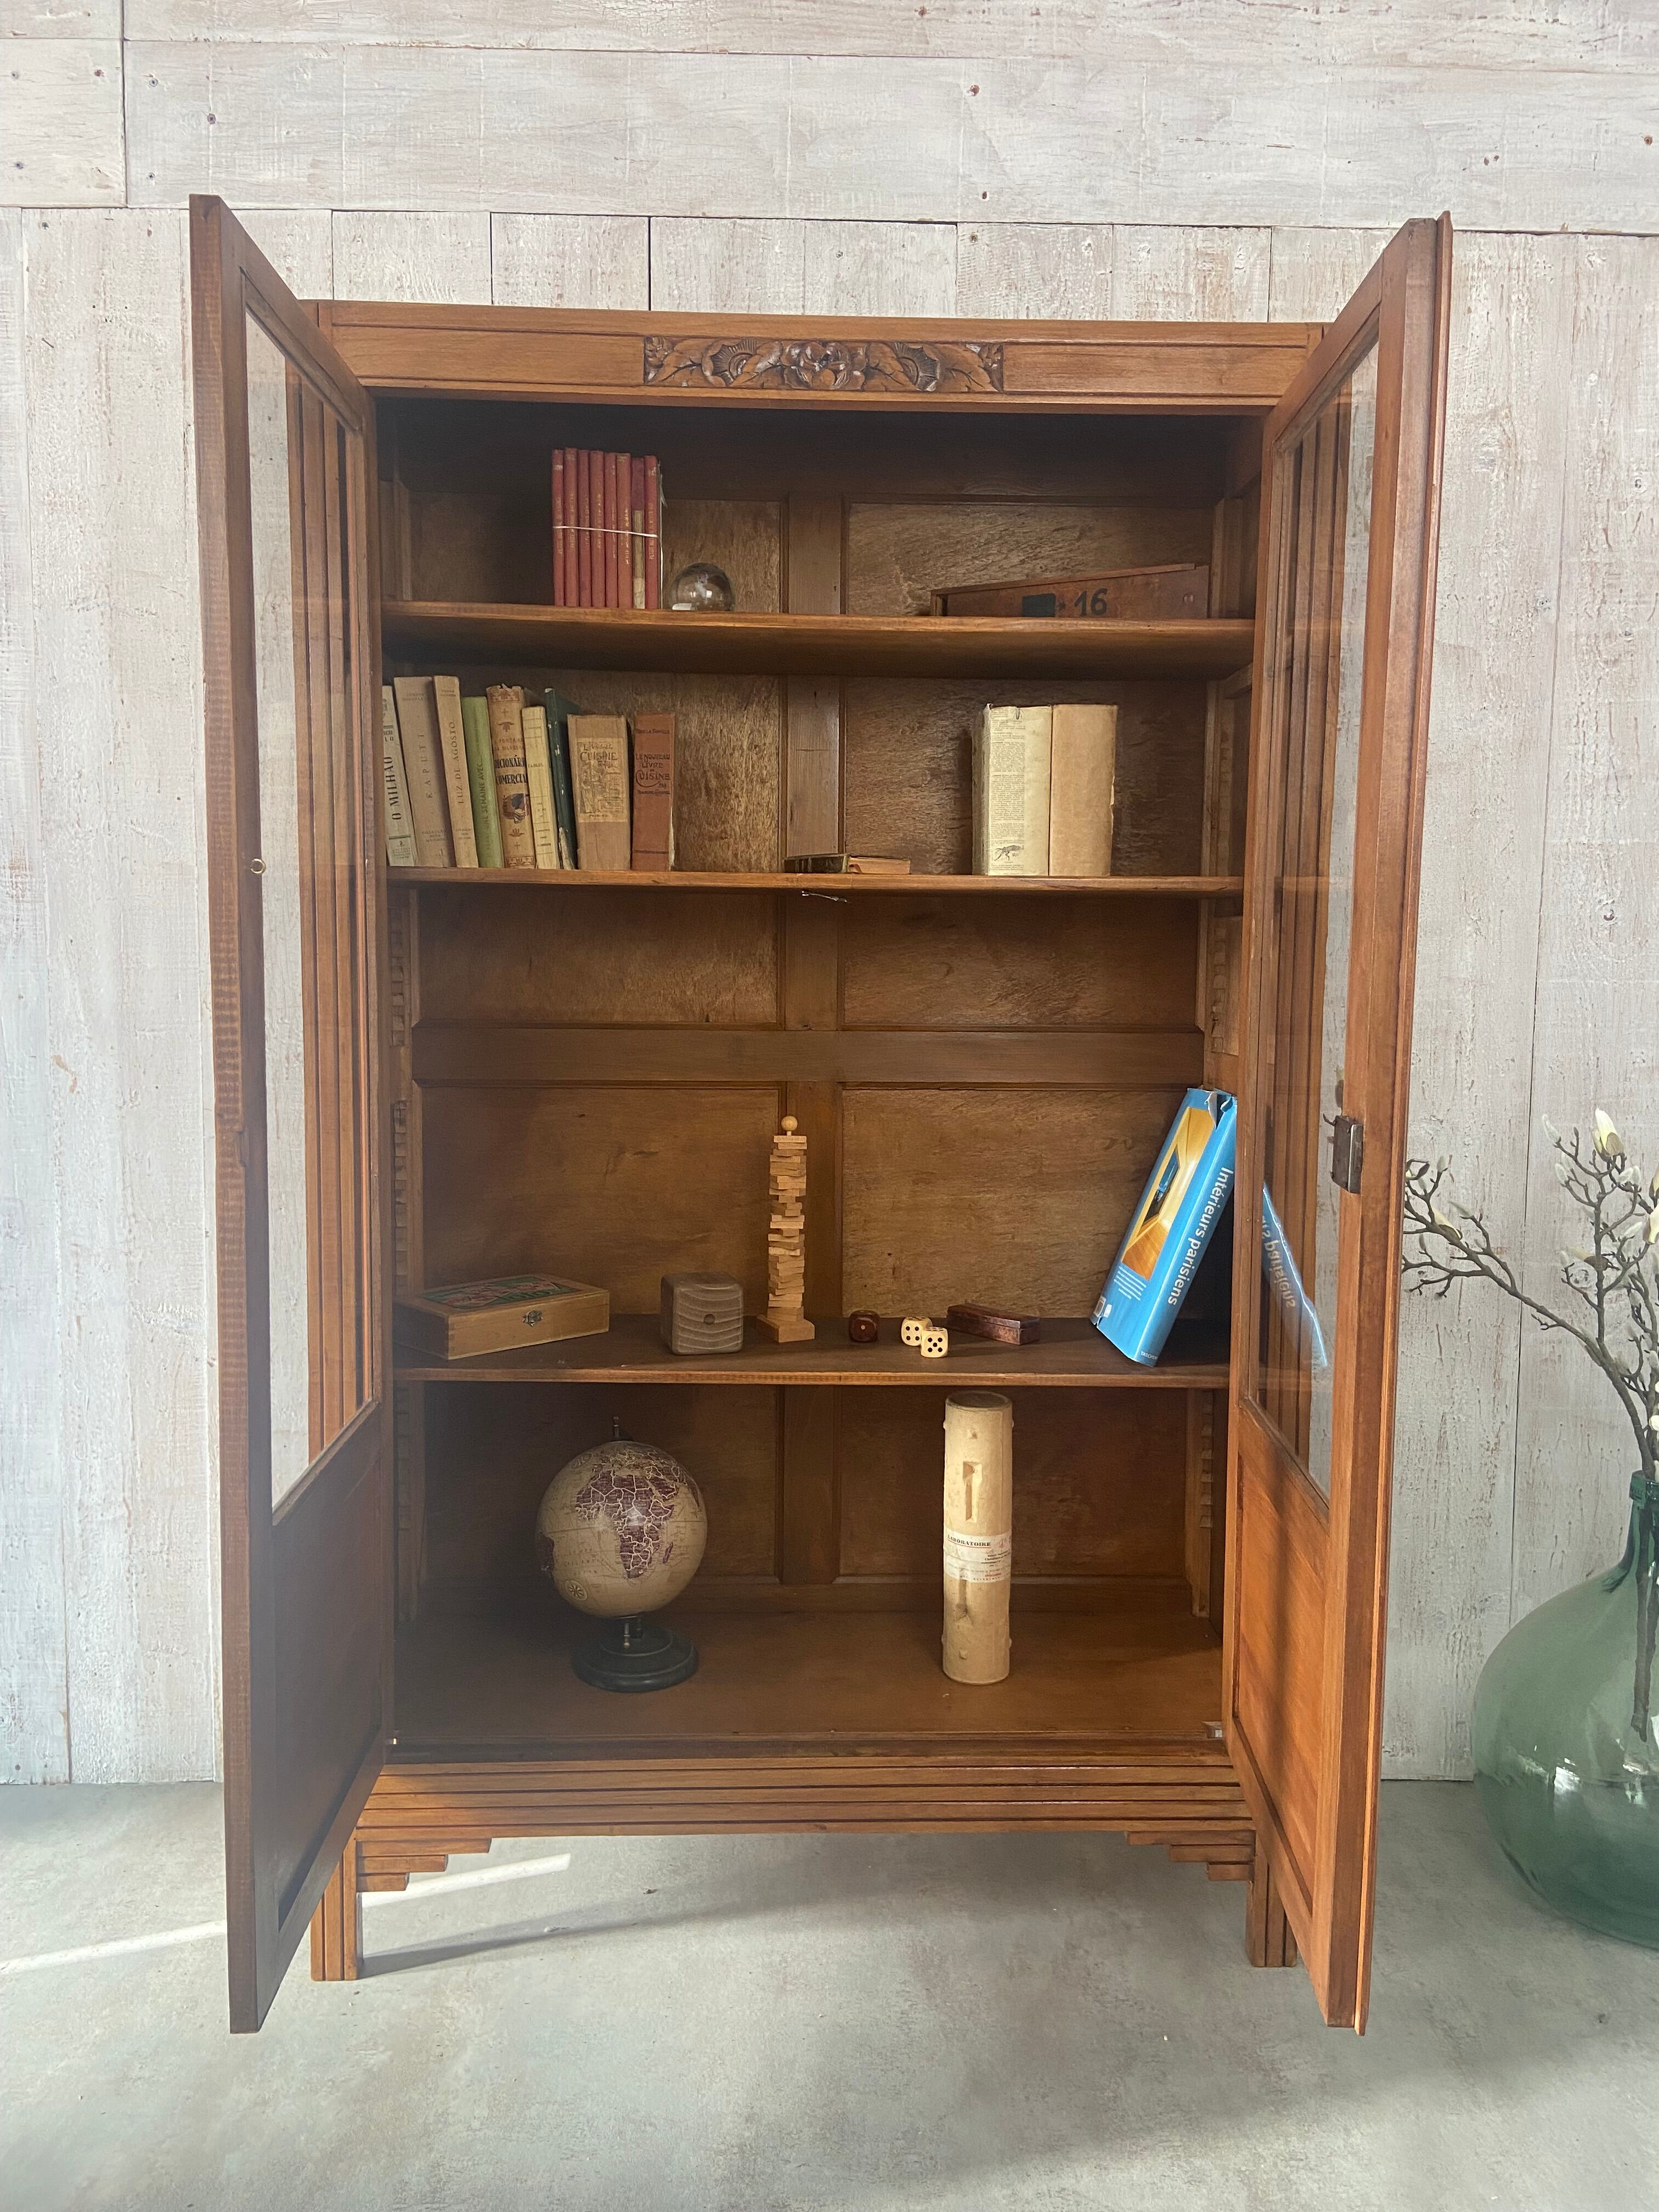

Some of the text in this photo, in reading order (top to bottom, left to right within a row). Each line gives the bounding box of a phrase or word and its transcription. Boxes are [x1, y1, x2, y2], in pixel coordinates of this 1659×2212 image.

[1074, 588, 1108, 617] 16
[449, 722, 459, 761] AGOSTO
[580, 751, 618, 761] CUISINE
[417, 733, 433, 798] KAPUTT
[454, 768, 461, 779] DE
[478, 782, 488, 813] SEMAINE
[1168, 1167, 1234, 1306] Intérieurs parisiens
[947, 1534, 991, 1547] LABORATOIRE
